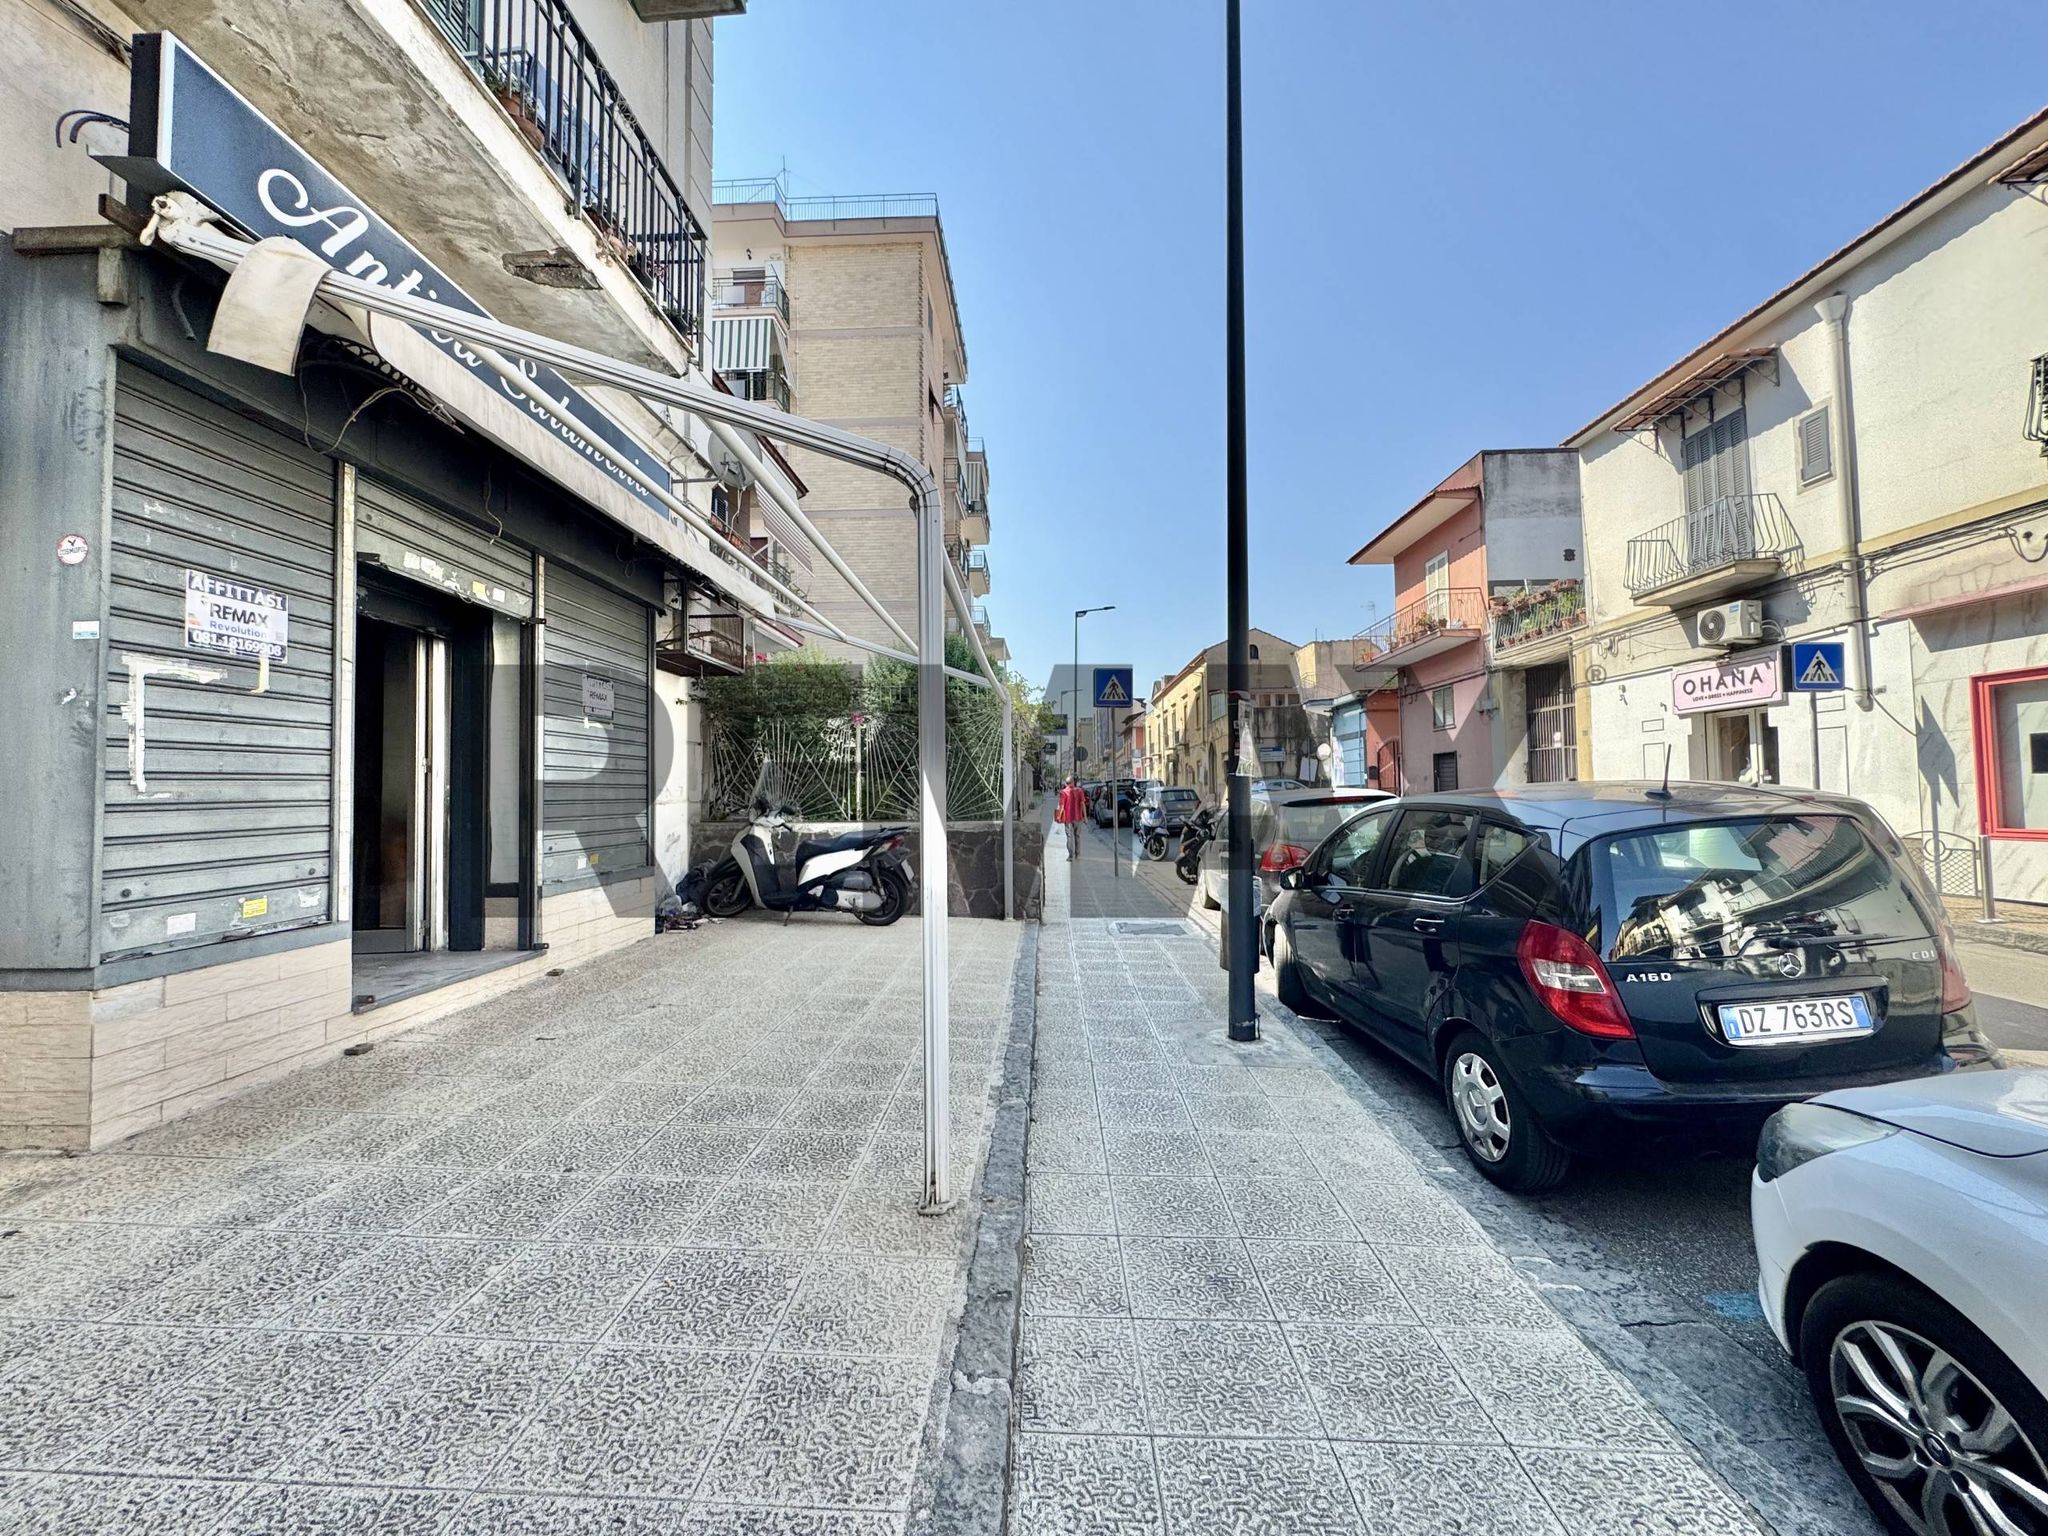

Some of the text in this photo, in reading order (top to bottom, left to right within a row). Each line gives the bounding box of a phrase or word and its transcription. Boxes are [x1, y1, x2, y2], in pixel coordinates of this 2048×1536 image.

[190, 574, 284, 611] AFFITTASI
[209, 620, 268, 639] Revolution
[1683, 666, 1764, 695] OHANA
[1739, 1000, 1854, 1034] DZ 763RS
